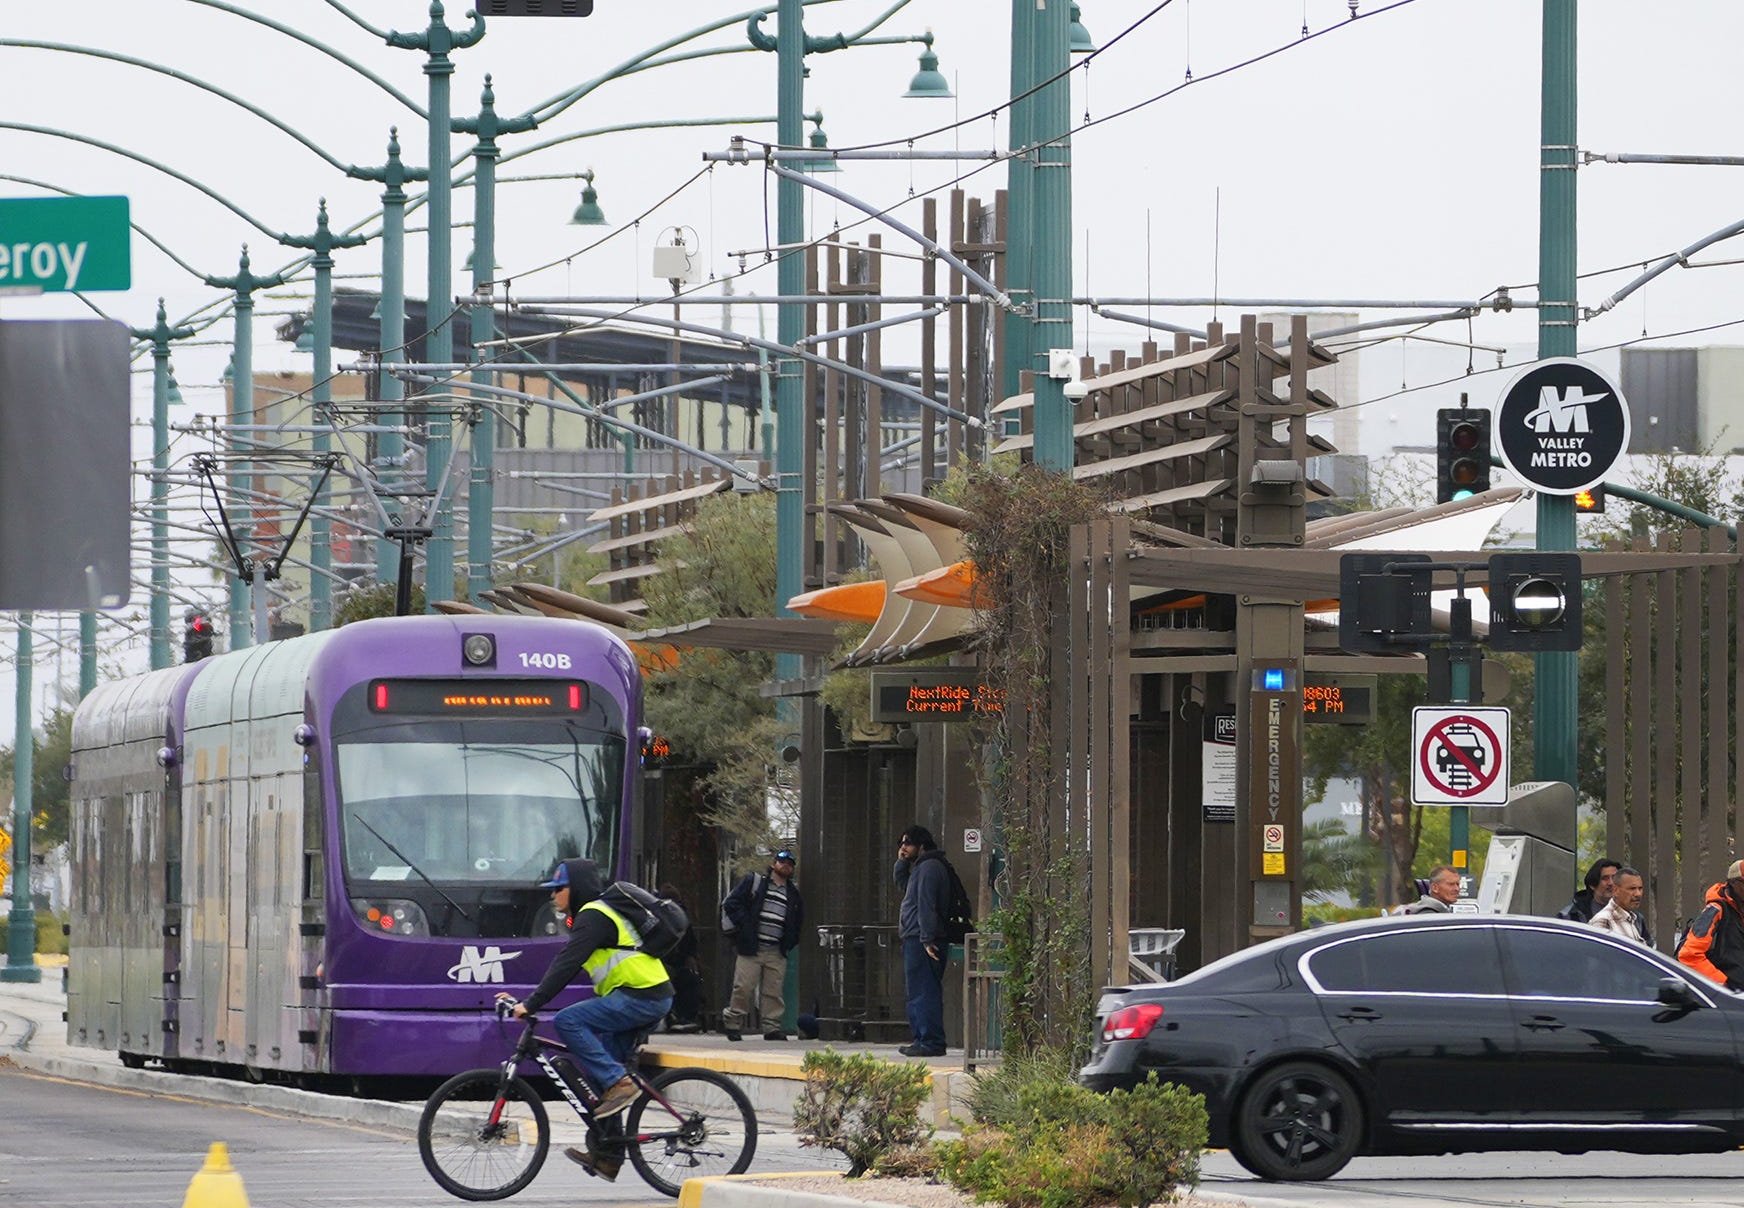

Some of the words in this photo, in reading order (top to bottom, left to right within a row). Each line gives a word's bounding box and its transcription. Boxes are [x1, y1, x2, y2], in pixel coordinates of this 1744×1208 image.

[1538, 437, 1584, 449] VALLEY
[1530, 452, 1592, 468] METRO
[519, 652, 572, 669] 140B
[909, 685, 970, 699] NextRide
[906, 698, 963, 713] Current
[1325, 700, 1344, 713] PM
[1268, 698, 1280, 821] EMERGENCY
